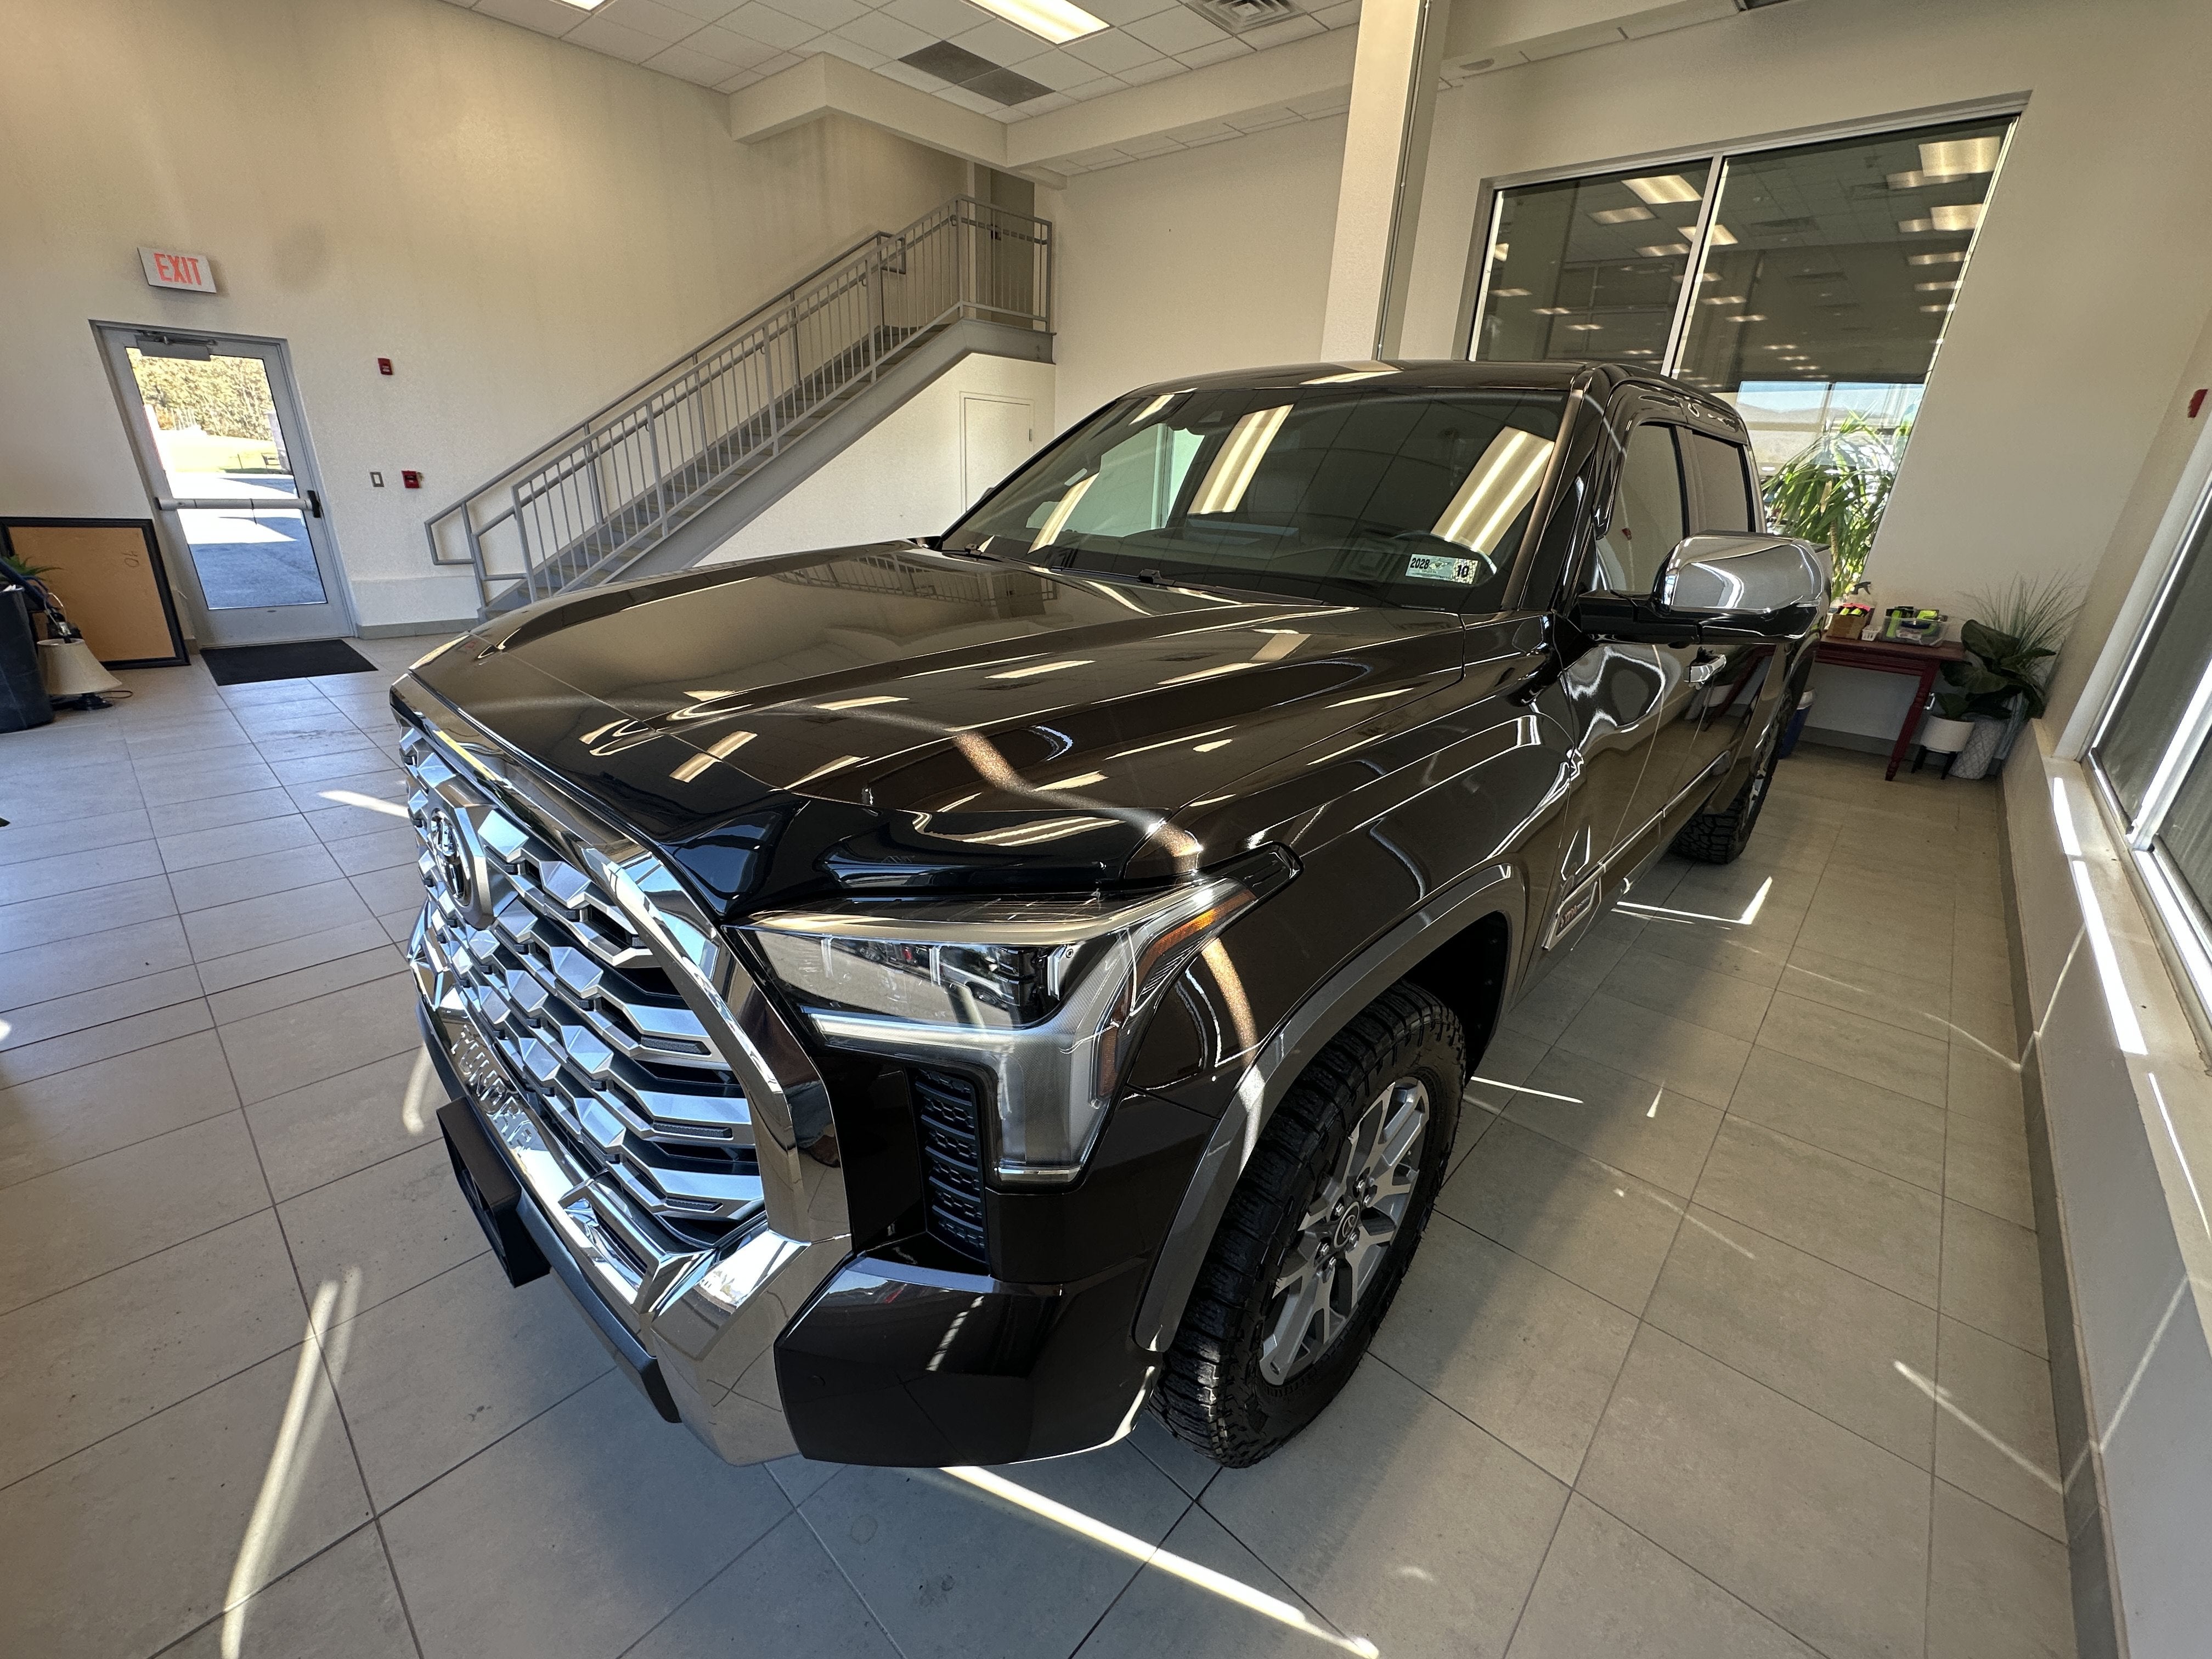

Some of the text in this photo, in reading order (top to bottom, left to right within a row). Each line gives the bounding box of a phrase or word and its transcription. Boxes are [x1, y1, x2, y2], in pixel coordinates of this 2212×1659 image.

[154, 253, 202, 286] EXIT
[1410, 557, 1430, 569] 2028
[1457, 565, 1469, 578] 10
[451, 1024, 538, 1156] TUNDRA
